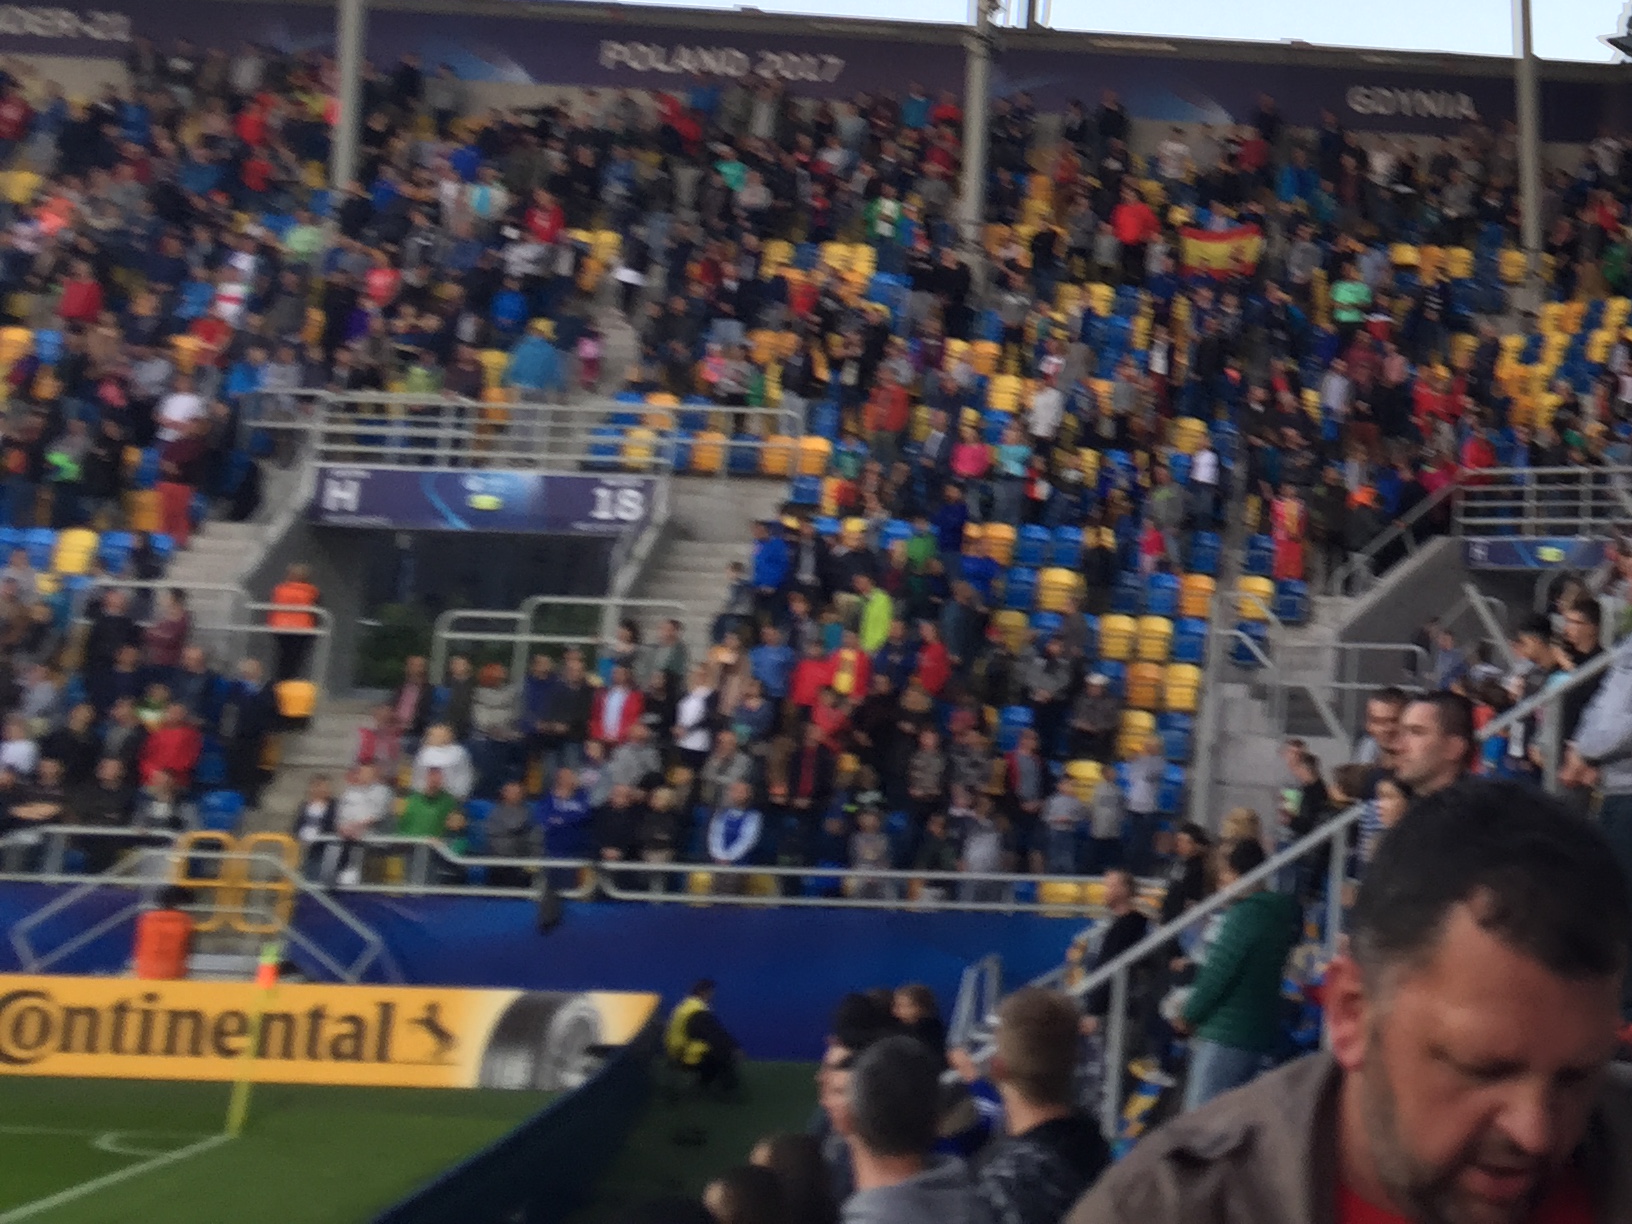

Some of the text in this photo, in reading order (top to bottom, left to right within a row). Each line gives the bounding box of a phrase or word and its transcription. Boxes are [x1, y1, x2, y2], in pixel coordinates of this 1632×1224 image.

[600, 40, 843, 83] POLAND 2017
[1346, 85, 1480, 121] GDYNIA
[0, 989, 397, 1066] Continental
